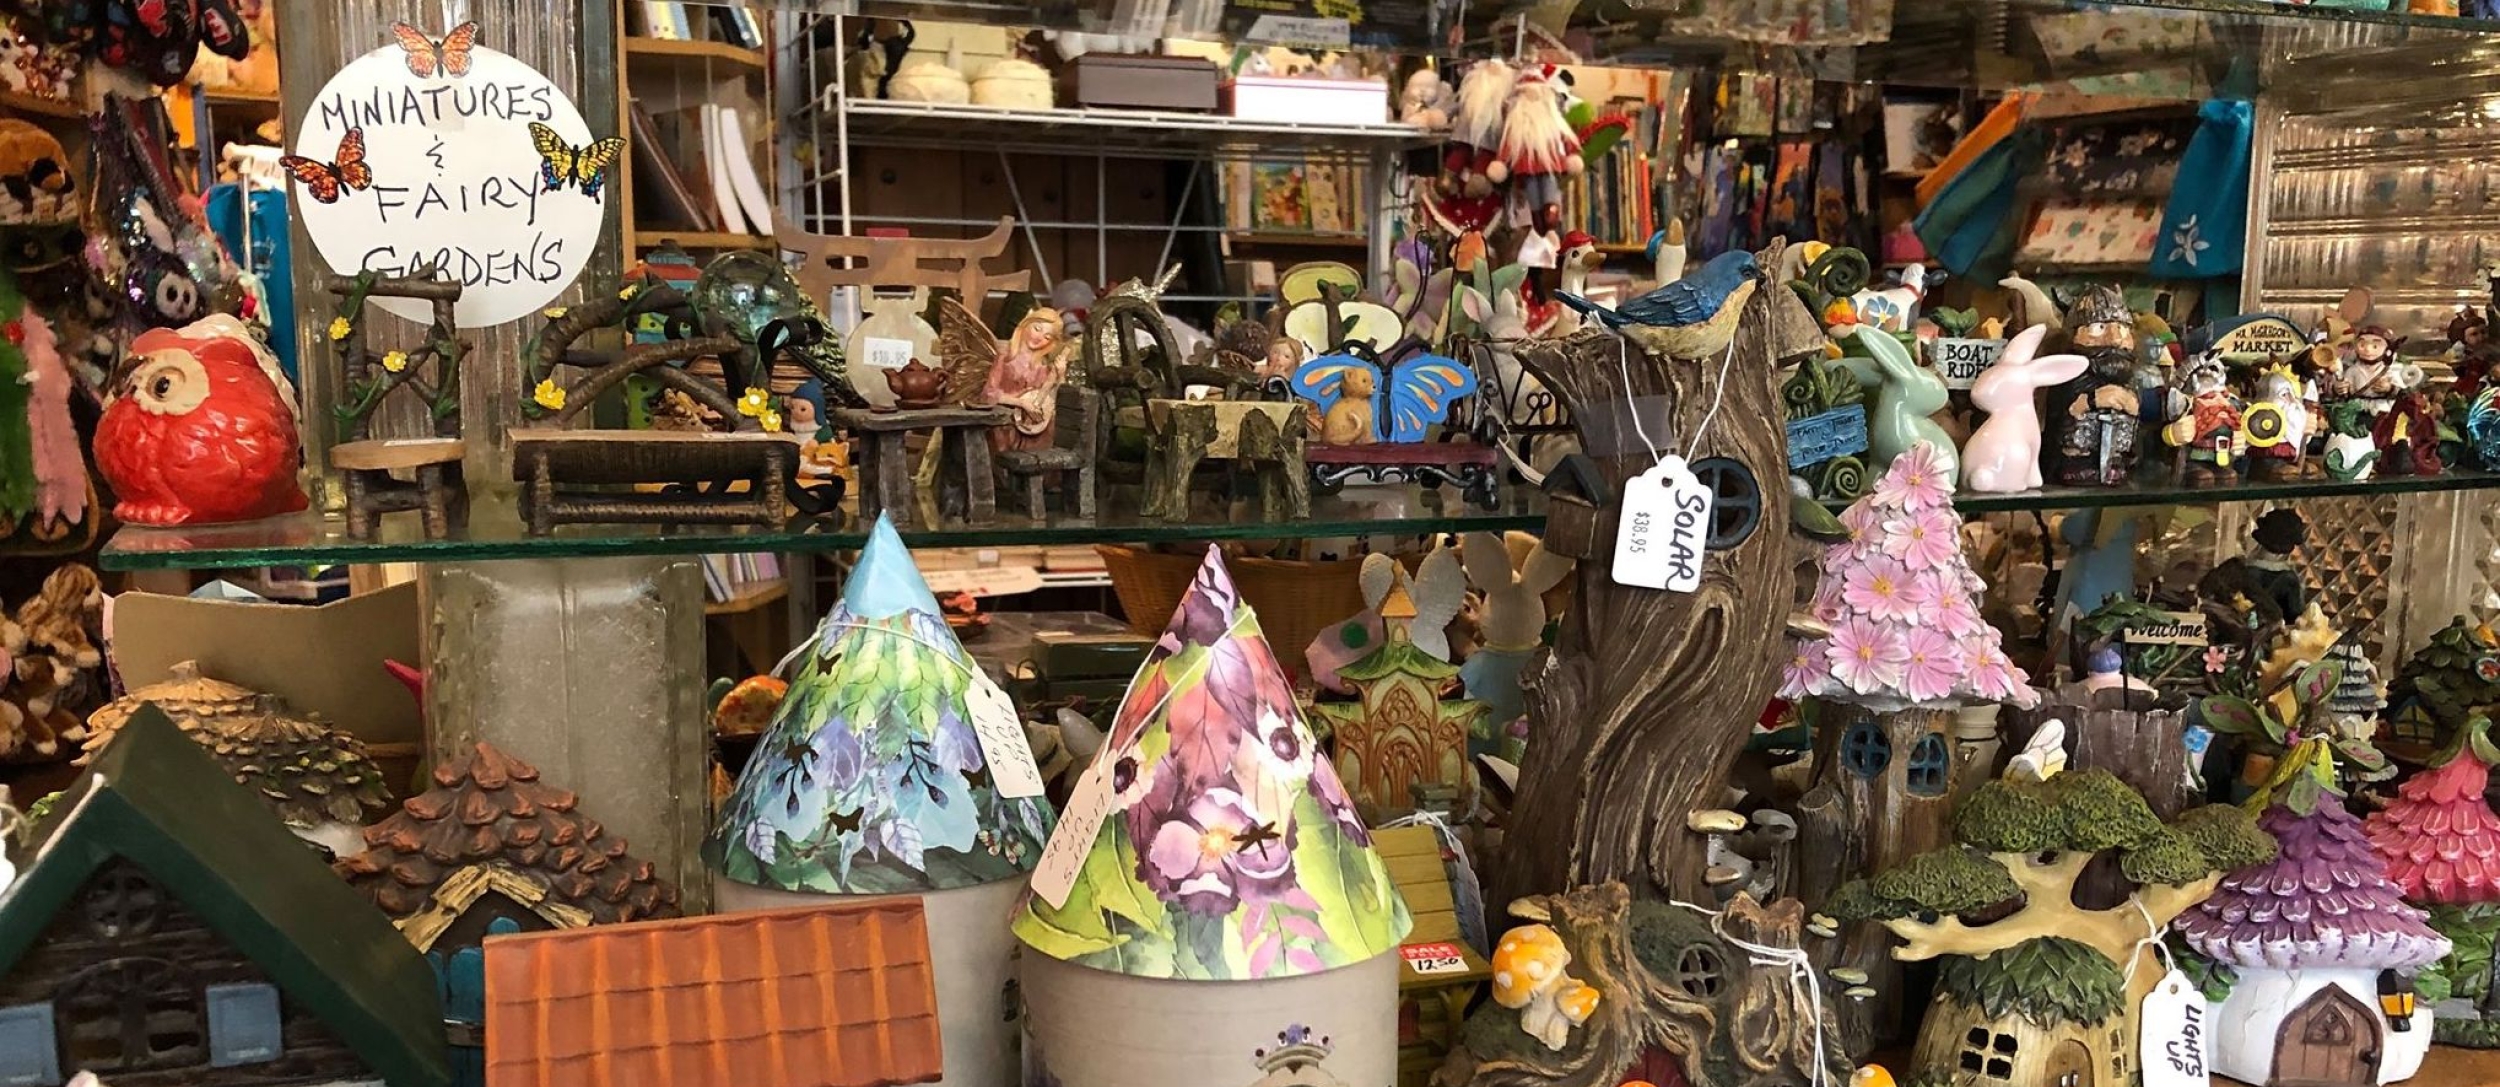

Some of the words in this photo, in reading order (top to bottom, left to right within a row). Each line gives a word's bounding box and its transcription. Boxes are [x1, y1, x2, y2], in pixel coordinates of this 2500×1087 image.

[321, 82, 553, 131] MINIATURES
[372, 171, 539, 226] FAIRY
[1945, 343, 1993, 366] BOAT
[2233, 340, 2293, 353] MARKET
[1629, 511, 1651, 553] $38.95
[1665, 489, 1705, 590] SOLAR
[2165, 1040, 2184, 1071] UP
[2181, 1004, 2204, 1077] LIGHTS
